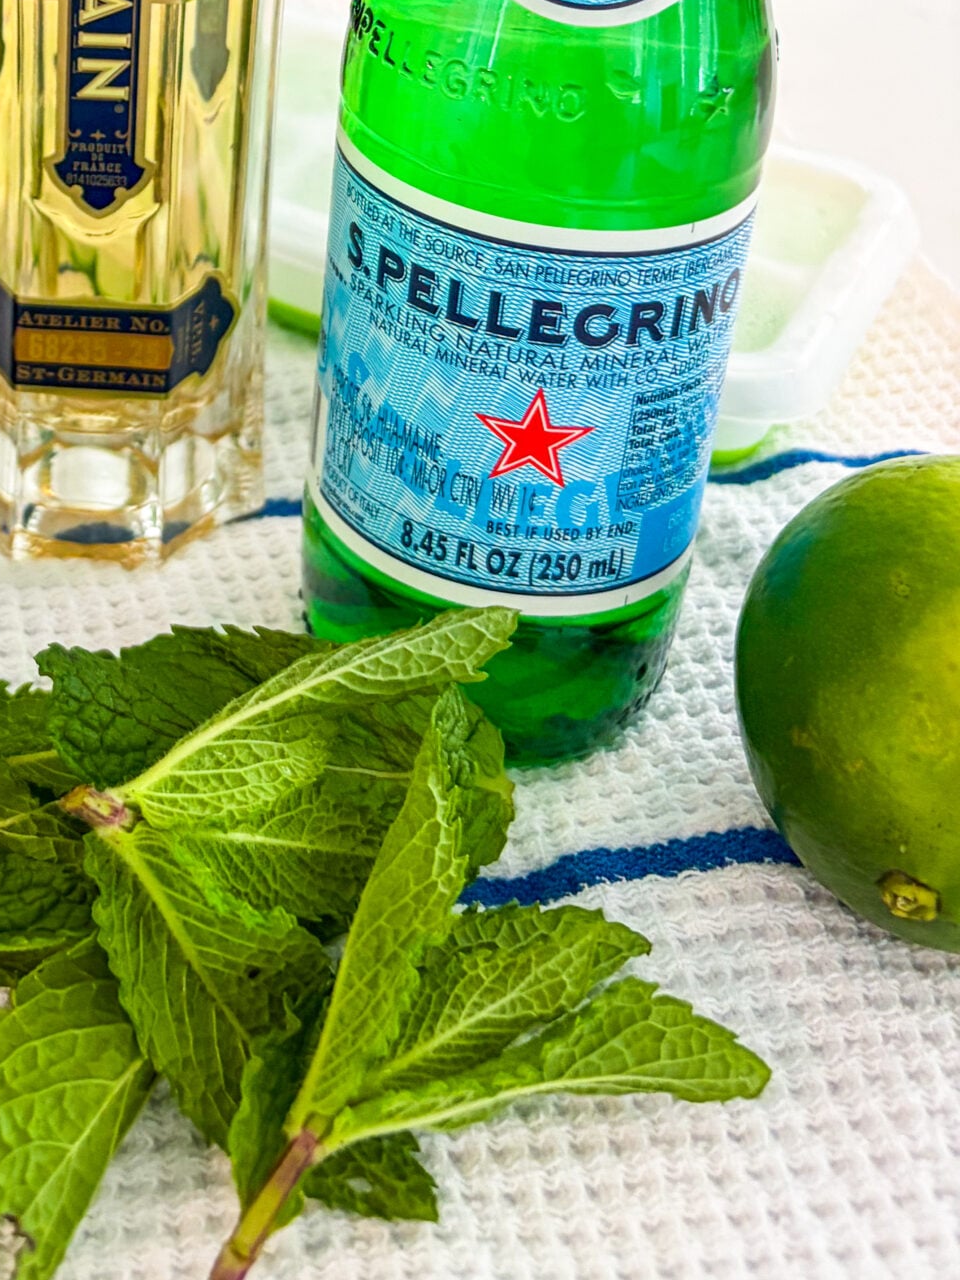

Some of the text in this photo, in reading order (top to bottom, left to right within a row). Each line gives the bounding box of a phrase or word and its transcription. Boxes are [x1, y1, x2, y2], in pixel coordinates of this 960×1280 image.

[71, 142, 126, 154] PRODUIT
[72, 161, 122, 174] FRANCE
[381, 213, 396, 232] AT
[399, 220, 421, 247] THE
[492, 256, 529, 279] SAN
[534, 265, 633, 288] PELLEGRINO
[637, 265, 681, 287] TERME
[17, 310, 121, 330] ATELIER
[349, 272, 446, 343] SPARKLING
[456, 330, 570, 372] NATURAL
[579, 345, 679, 371] MINERAL
[369, 311, 428, 357] NATURAL
[434, 346, 513, 382] MINERAL
[519, 368, 577, 389] WATER
[587, 370, 628, 389] WITH
[15, 364, 167, 388] ST-GERMAIN
[486, 520, 638, 541] BEST IF USED BY END:
[400, 519, 625, 587] 8.45 FL OZ (250 mL)
